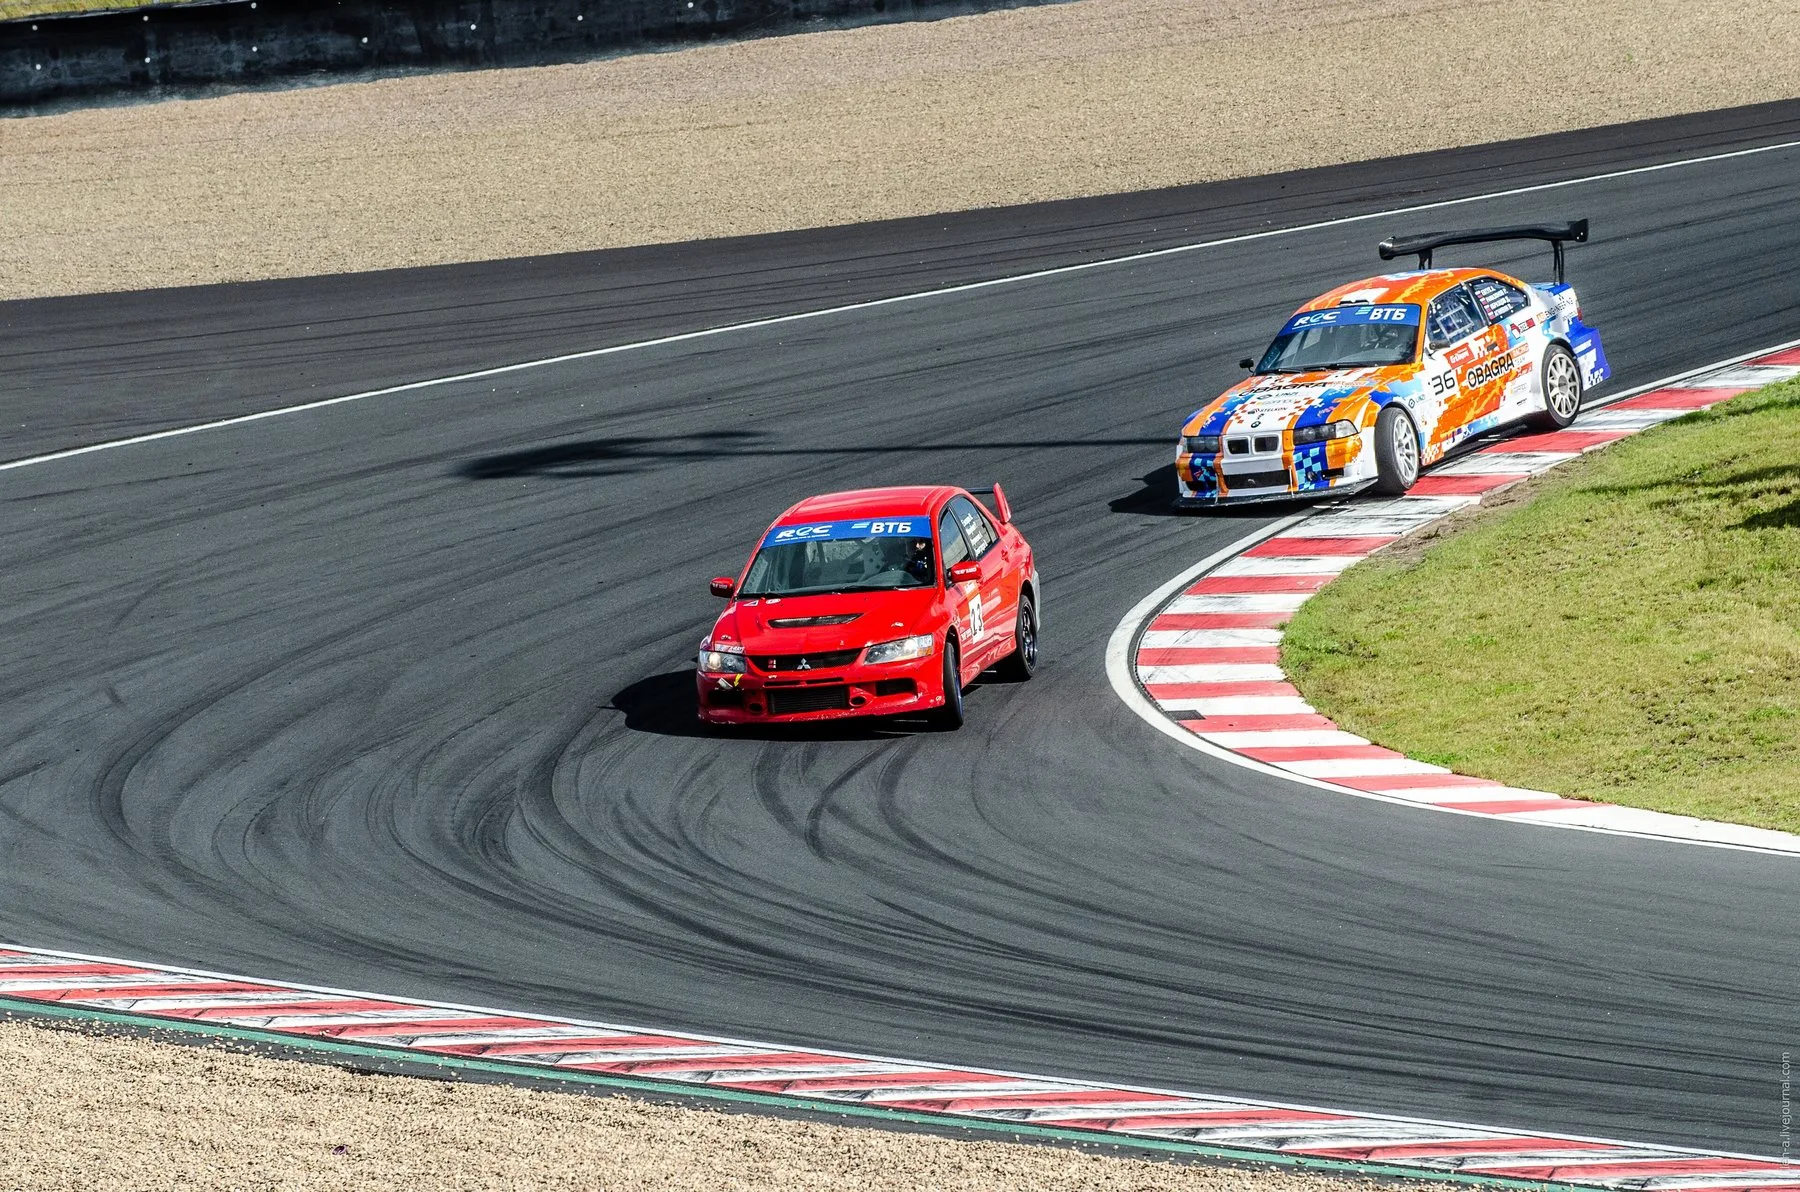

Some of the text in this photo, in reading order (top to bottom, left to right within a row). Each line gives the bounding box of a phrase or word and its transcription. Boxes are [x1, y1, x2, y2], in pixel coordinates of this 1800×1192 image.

[1369, 308, 1408, 321] ВТБ
[1467, 352, 1515, 388] OBAGRA
[1432, 370, 1456, 396] 36
[870, 522, 912, 534] ВТБ
